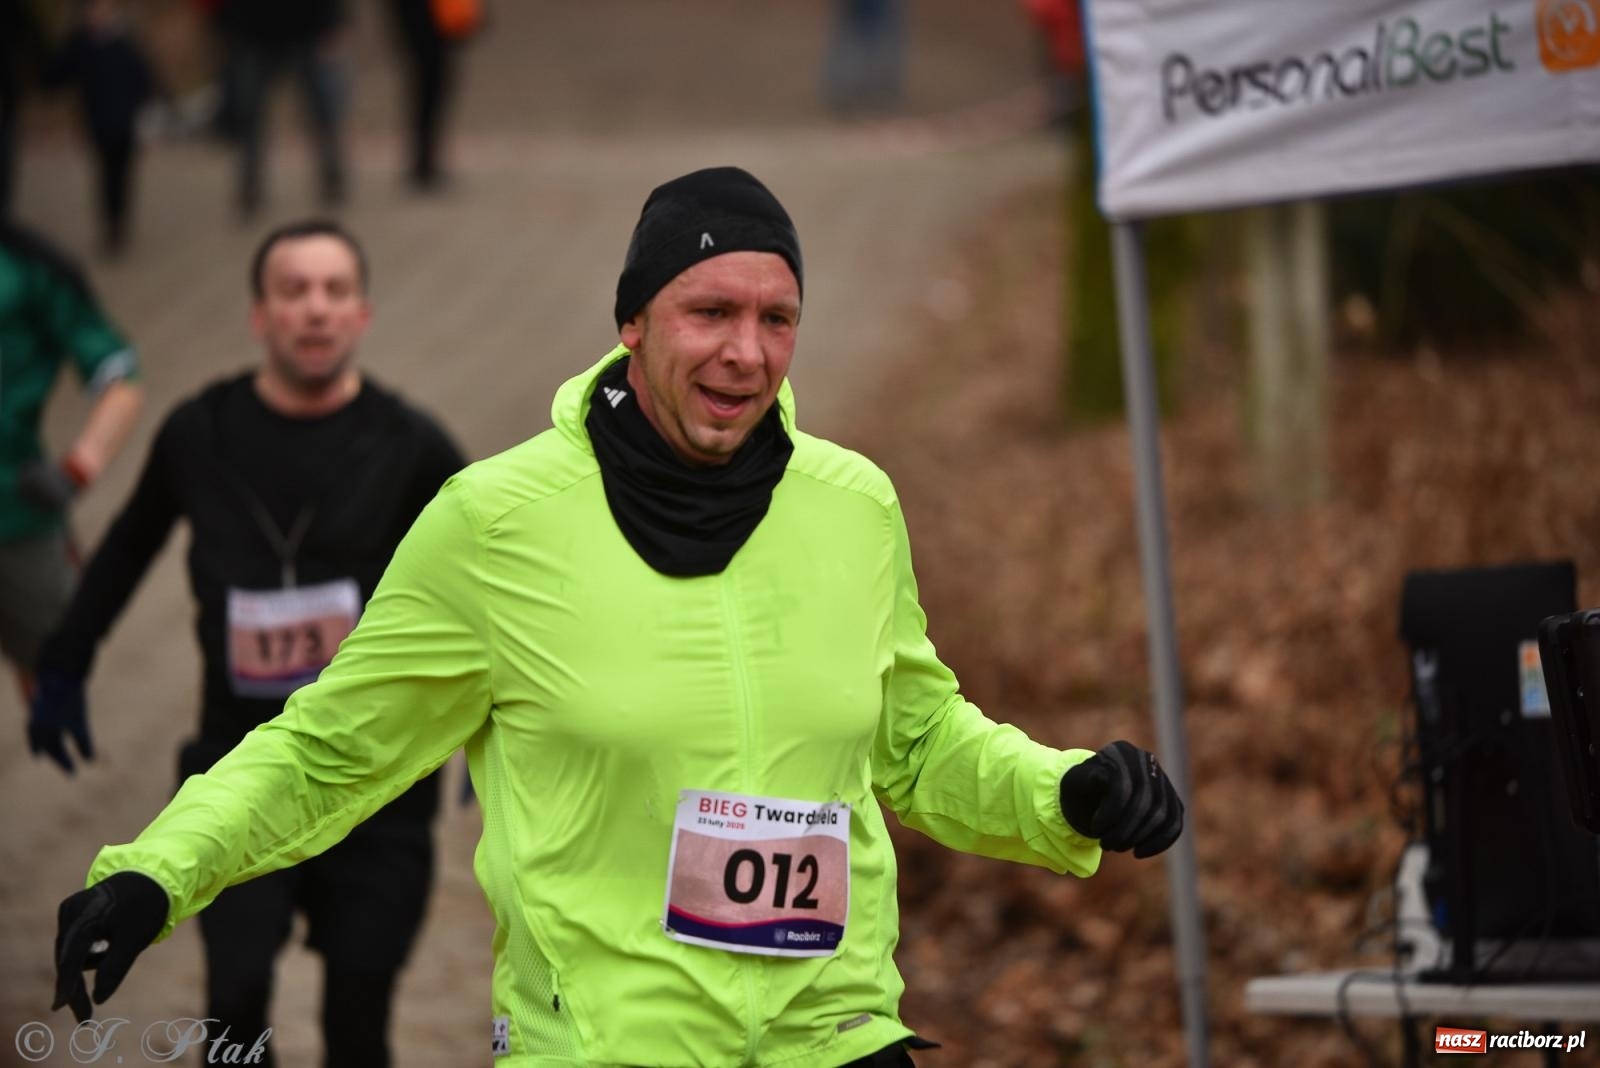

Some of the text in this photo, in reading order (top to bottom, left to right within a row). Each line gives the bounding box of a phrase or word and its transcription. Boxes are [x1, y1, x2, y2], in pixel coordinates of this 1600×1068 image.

[1162, 11, 1517, 122] PersonalBest
[699, 797, 748, 817] BIEG
[723, 848, 820, 910] 012
